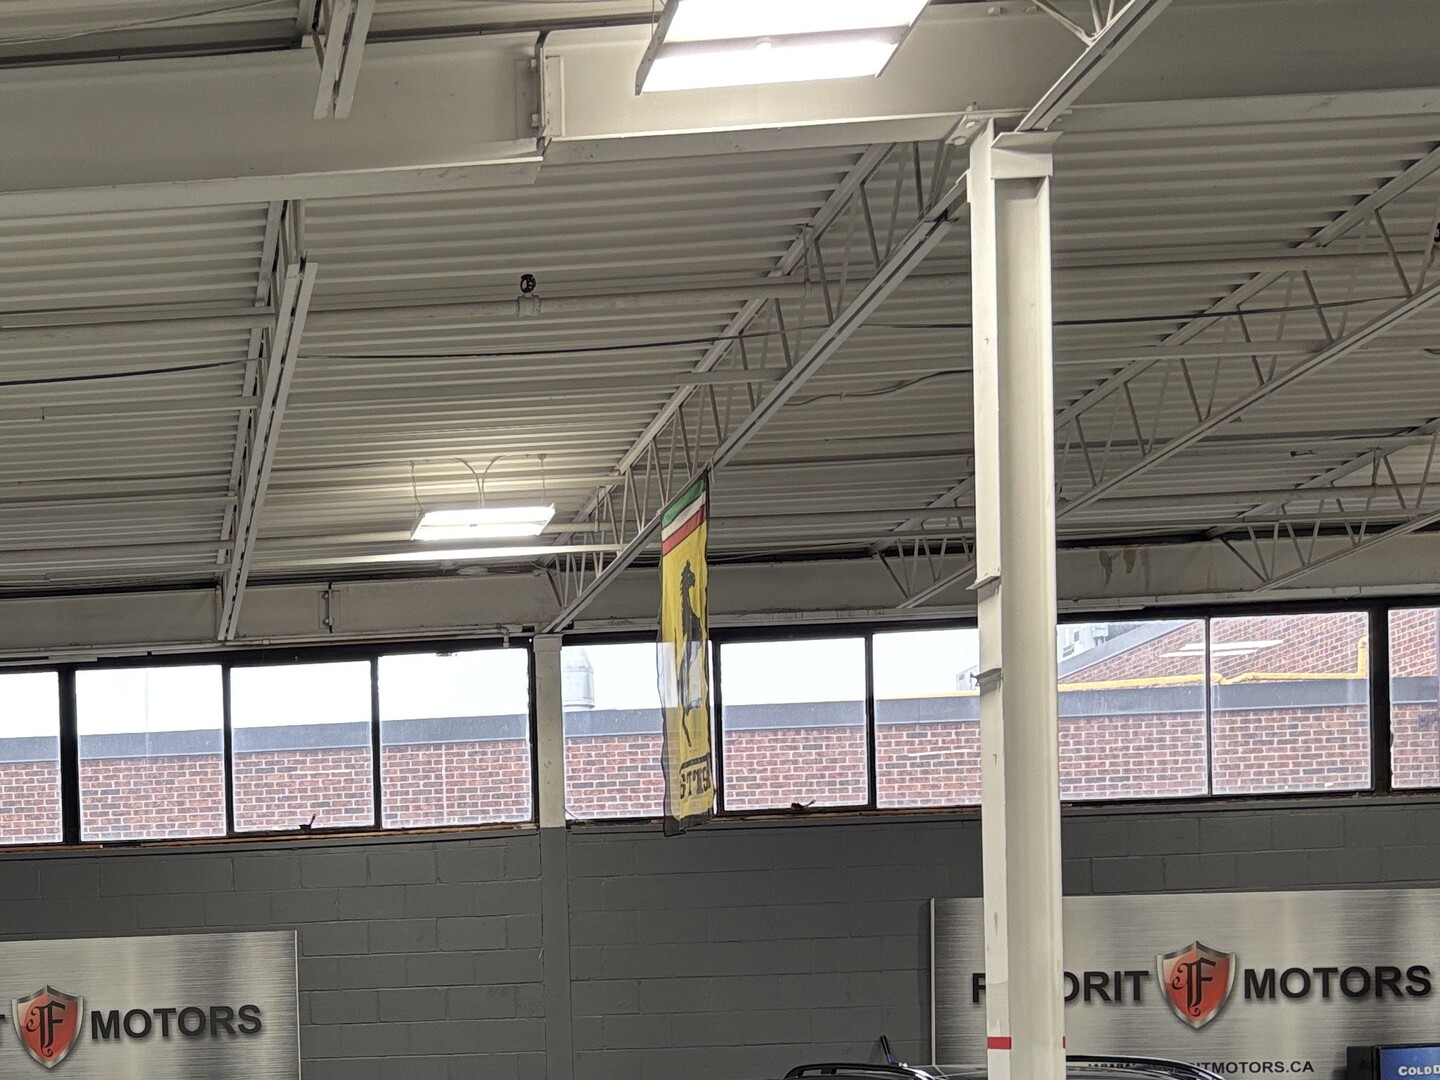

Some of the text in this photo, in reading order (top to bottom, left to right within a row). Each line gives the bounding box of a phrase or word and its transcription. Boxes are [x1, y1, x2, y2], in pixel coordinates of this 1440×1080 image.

[972, 970, 1149, 1003] FORIT
[1244, 965, 1432, 1000] MOTORS
[91, 1004, 263, 1040] MOTORS
[1190, 1060, 1315, 1074] TMOTORS.CA
[1398, 1065, 1432, 1076] COLD
